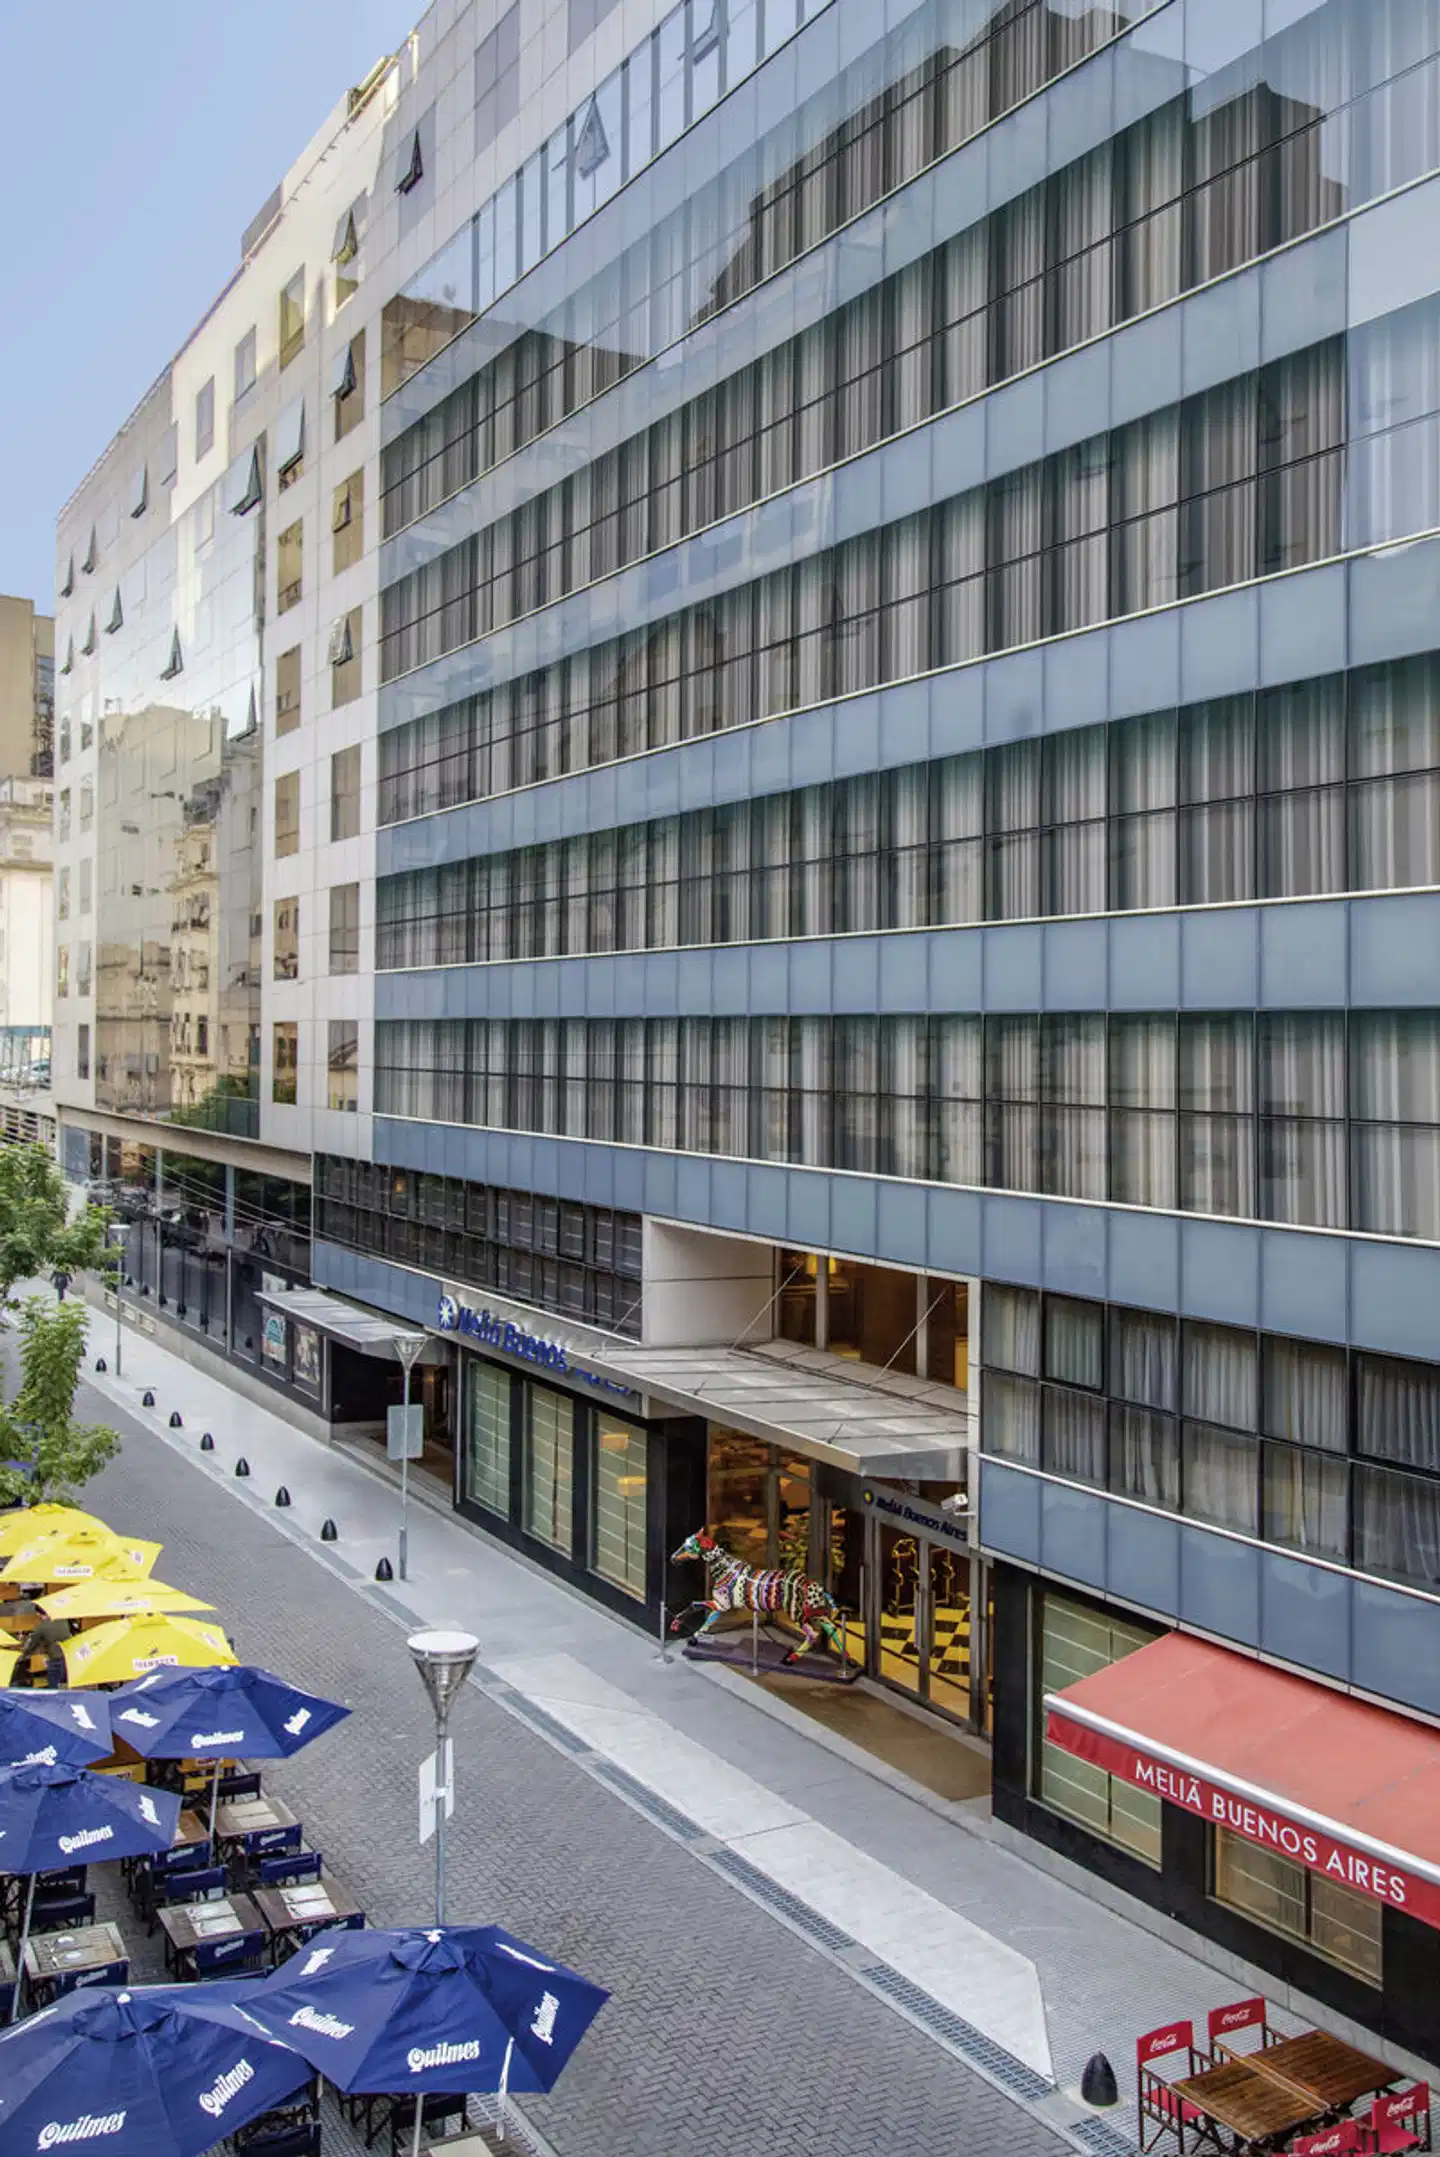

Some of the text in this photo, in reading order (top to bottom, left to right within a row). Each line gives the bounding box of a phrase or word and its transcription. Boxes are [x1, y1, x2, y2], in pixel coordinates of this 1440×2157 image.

[503, 1322, 568, 1374] Buenos
[59, 1825, 114, 1854] Quilmes
[1212, 1792, 1318, 1862] BUENOS
[1326, 1850, 1406, 1903] AIRES
[407, 2040, 480, 2073] Quilmes
[199, 2058, 255, 2118] Quilmes
[37, 2111, 127, 2150] Quilmes
